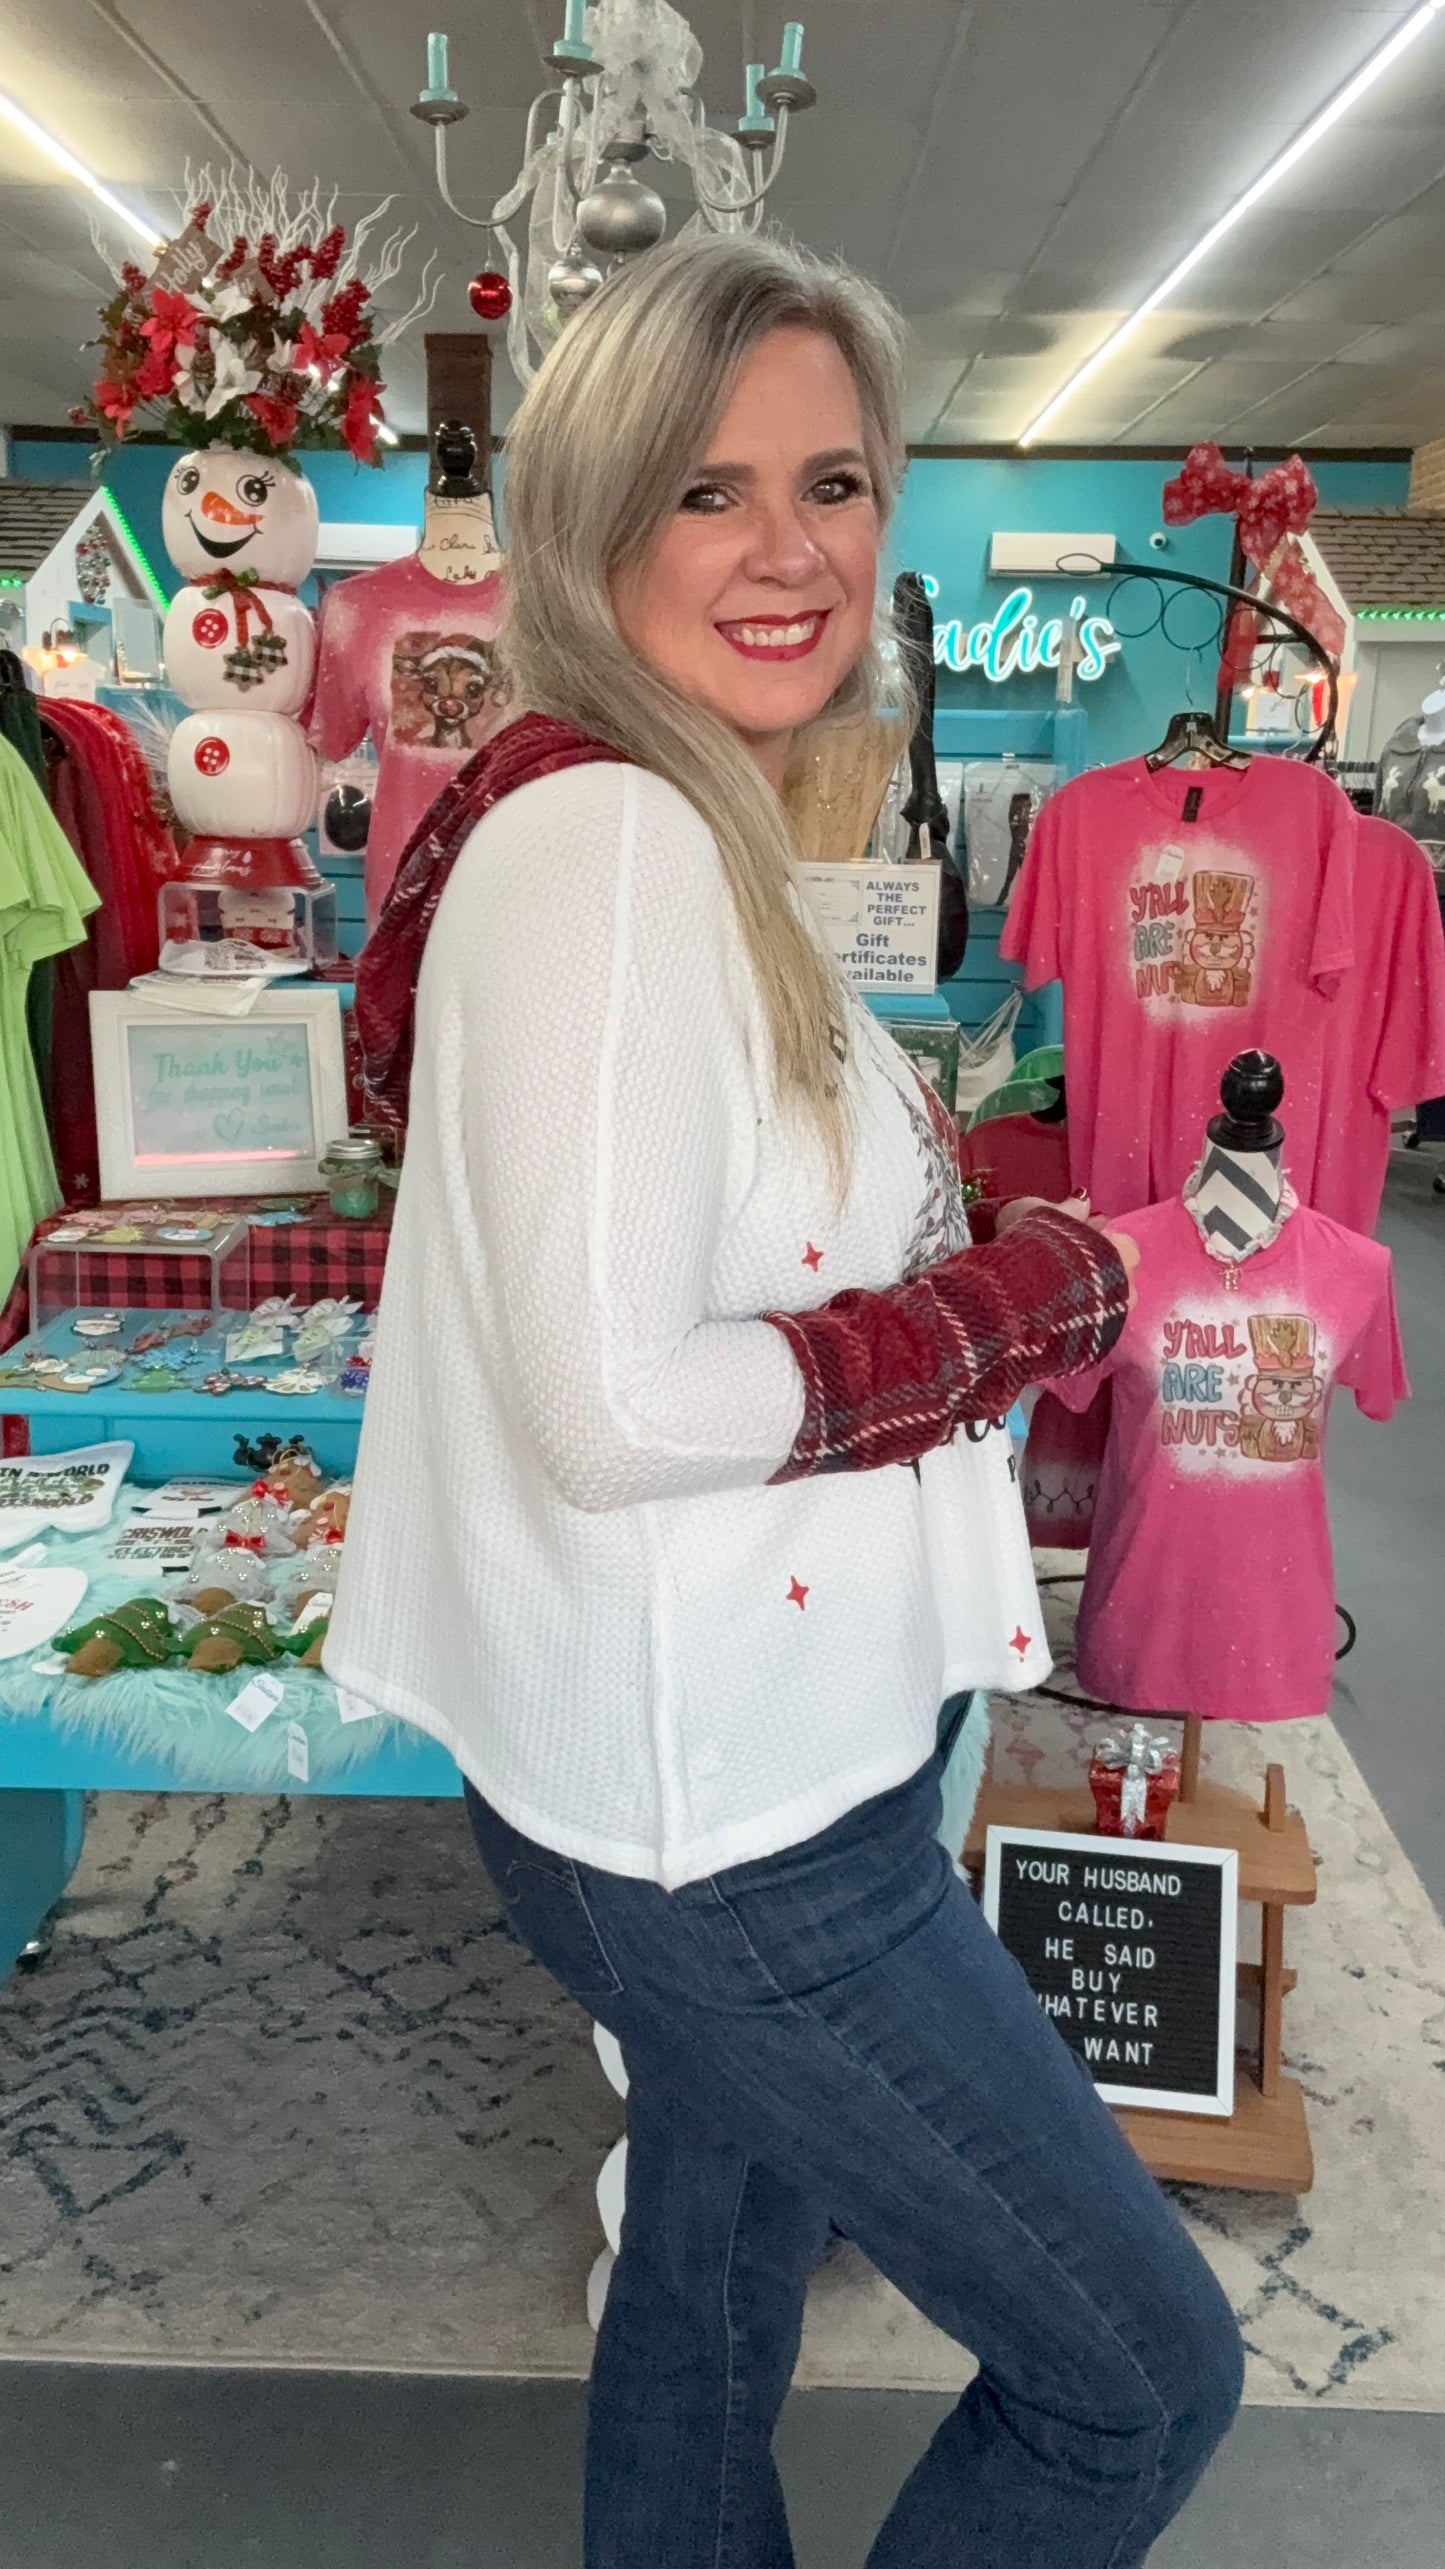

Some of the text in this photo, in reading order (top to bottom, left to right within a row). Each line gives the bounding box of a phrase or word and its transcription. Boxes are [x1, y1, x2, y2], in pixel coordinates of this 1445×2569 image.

[921, 574, 1122, 682] adie's
[866, 881, 920, 892] ALWAYS
[876, 893, 903, 903] THE
[867, 904, 927, 915] PERFECT
[873, 916, 915, 927] GIFT...
[856, 933, 890, 947] Gift
[1134, 922, 1174, 961] ARE
[834, 951, 927, 966] ertificates
[847, 968, 914, 982] ailable
[154, 1048, 282, 1083] Thank You
[1163, 1319, 1248, 1359] Y'ALL
[1163, 1362, 1225, 1403] ARE
[1161, 1408, 1240, 1447] NUTS
[1016, 1859, 1182, 1896] YOUR HUSBAND
[1045, 1937, 1156, 1969] HE SAID
[1072, 1969, 1121, 1994] BUY
[1037, 1993, 1158, 2027] HATEVER
[1084, 2037, 1153, 2065] WANT
